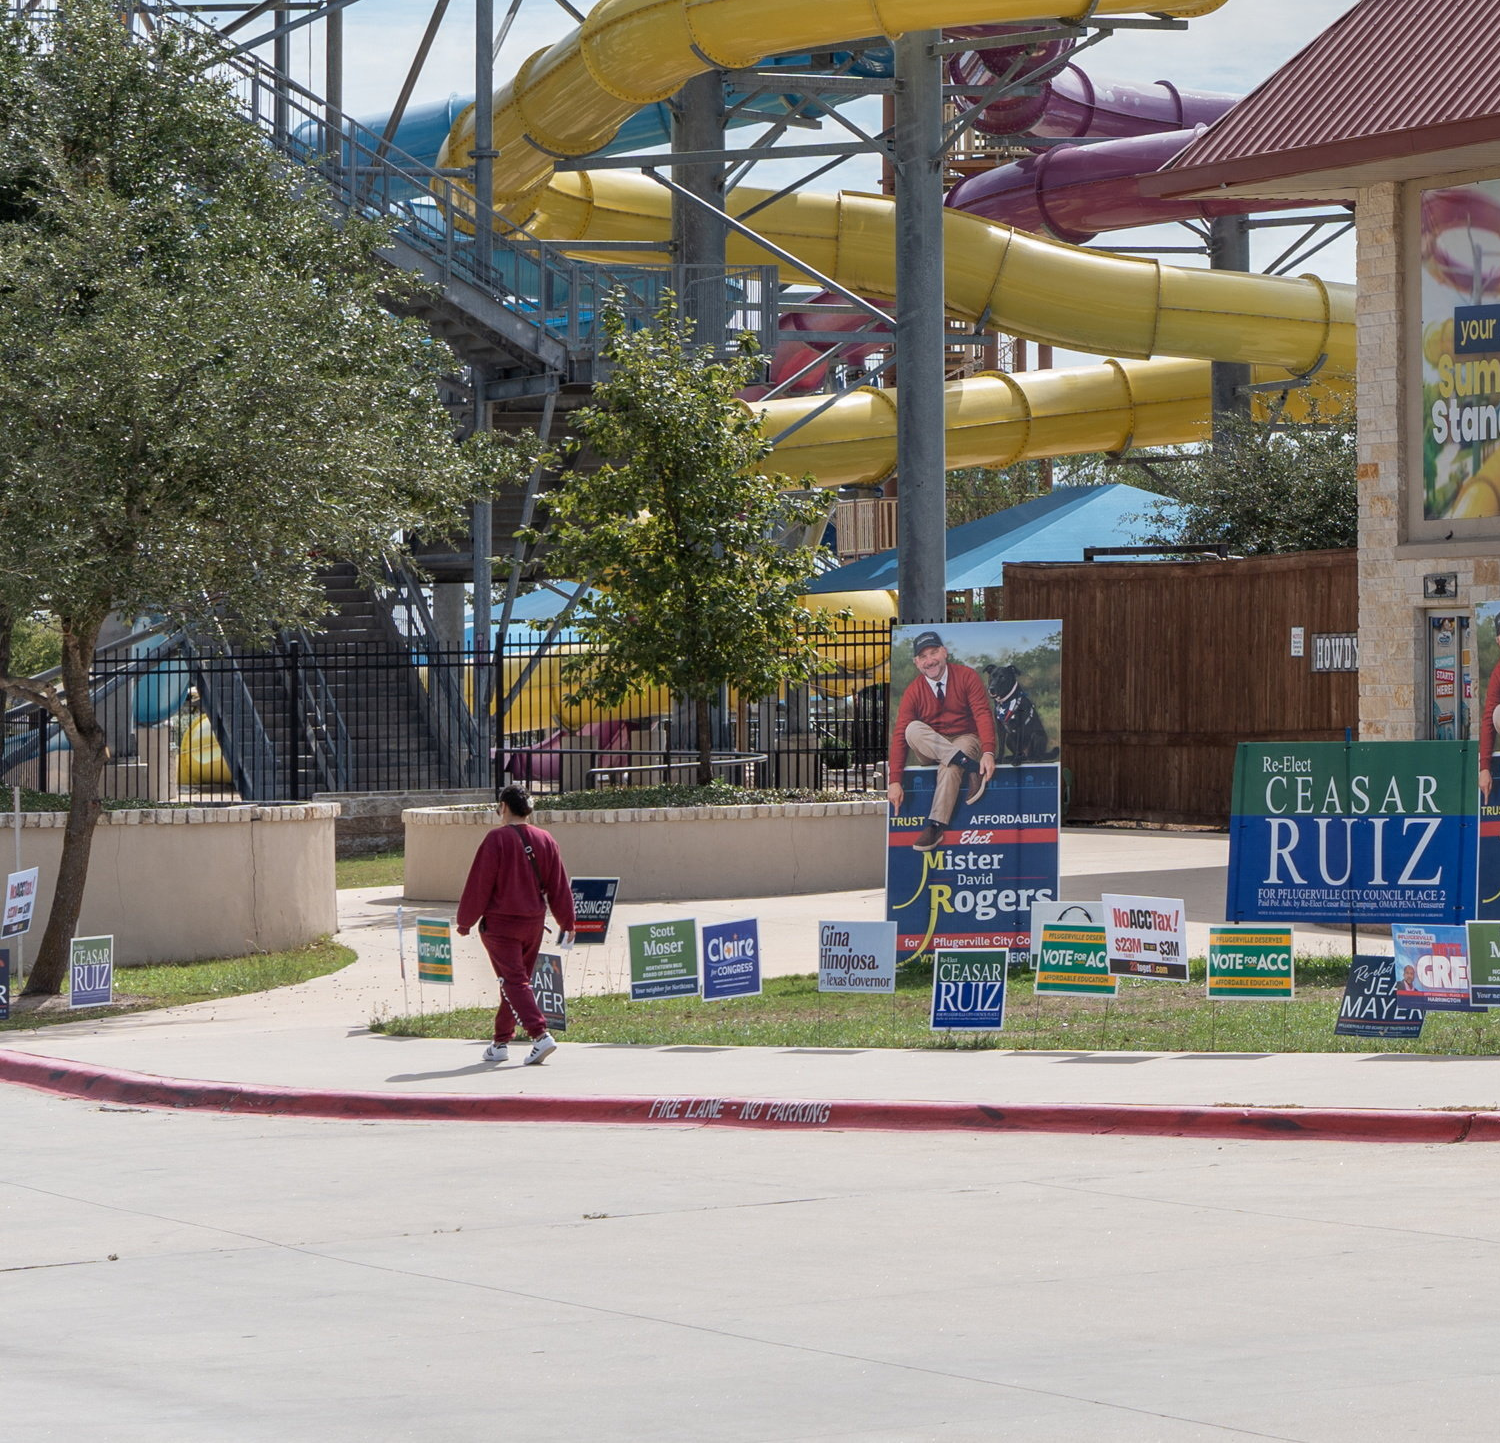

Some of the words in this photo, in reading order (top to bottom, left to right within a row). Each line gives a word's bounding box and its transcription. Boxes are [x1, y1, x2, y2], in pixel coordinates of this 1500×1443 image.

[1461, 318, 1497, 346] your
[1435, 669, 1455, 682] STARTS
[1263, 756, 1312, 773] Re-Elect
[1265, 775, 1442, 814] CEASAR
[890, 816, 925, 827] TRUST
[969, 813, 1057, 825] AFFORDABILITY
[959, 830, 994, 845] Elect
[922, 850, 1004, 871] Mister
[1263, 818, 1443, 886] RUIZ
[957, 873, 993, 886] David
[928, 884, 1053, 921] Rogers
[1258, 888, 1276, 899] FOR
[1278, 889, 1340, 900] PFLUGERVILLE
[1341, 889, 1362, 900] CITY
[1363, 890, 1404, 901] COUNCIL
[1405, 890, 1439, 901] PLACE
[1439, 890, 1446, 901] 2
[575, 900, 612, 914] ESSINGER
[650, 926, 676, 938] Scott
[820, 924, 851, 947] Gina
[435, 944, 450, 958] ACC
[643, 940, 684, 957] Moser
[707, 935, 755, 962] Claire
[904, 938, 920, 947] for
[933, 937, 991, 948] Pflugerville
[992, 936, 1014, 947] City
[1115, 938, 1142, 954] $23M
[1159, 941, 1180, 957] $3M
[74, 948, 110, 966] CEASAR
[820, 947, 880, 974] Hinojosa.
[1042, 949, 1074, 966] VOTE
[1074, 953, 1087, 961] FOR
[1086, 951, 1108, 967] AC
[1211, 953, 1244, 969] VOTE
[1244, 956, 1258, 964] FOR
[1256, 953, 1289, 970] ACC
[74, 964, 110, 992] RUIZ
[711, 968, 719, 977] for
[718, 962, 755, 975] CONGRESS
[939, 963, 1002, 982] CEASAR
[1416, 955, 1469, 989] GRE
[826, 973, 848, 987] Texas
[848, 974, 892, 988] Governor
[937, 982, 1003, 1012] RUIZ
[1476, 991, 1492, 999] Your
[648, 1097, 689, 1119] FIRE
[685, 1098, 727, 1119] LANE
[739, 1101, 764, 1120] NO
[766, 1101, 832, 1124] PARKING
